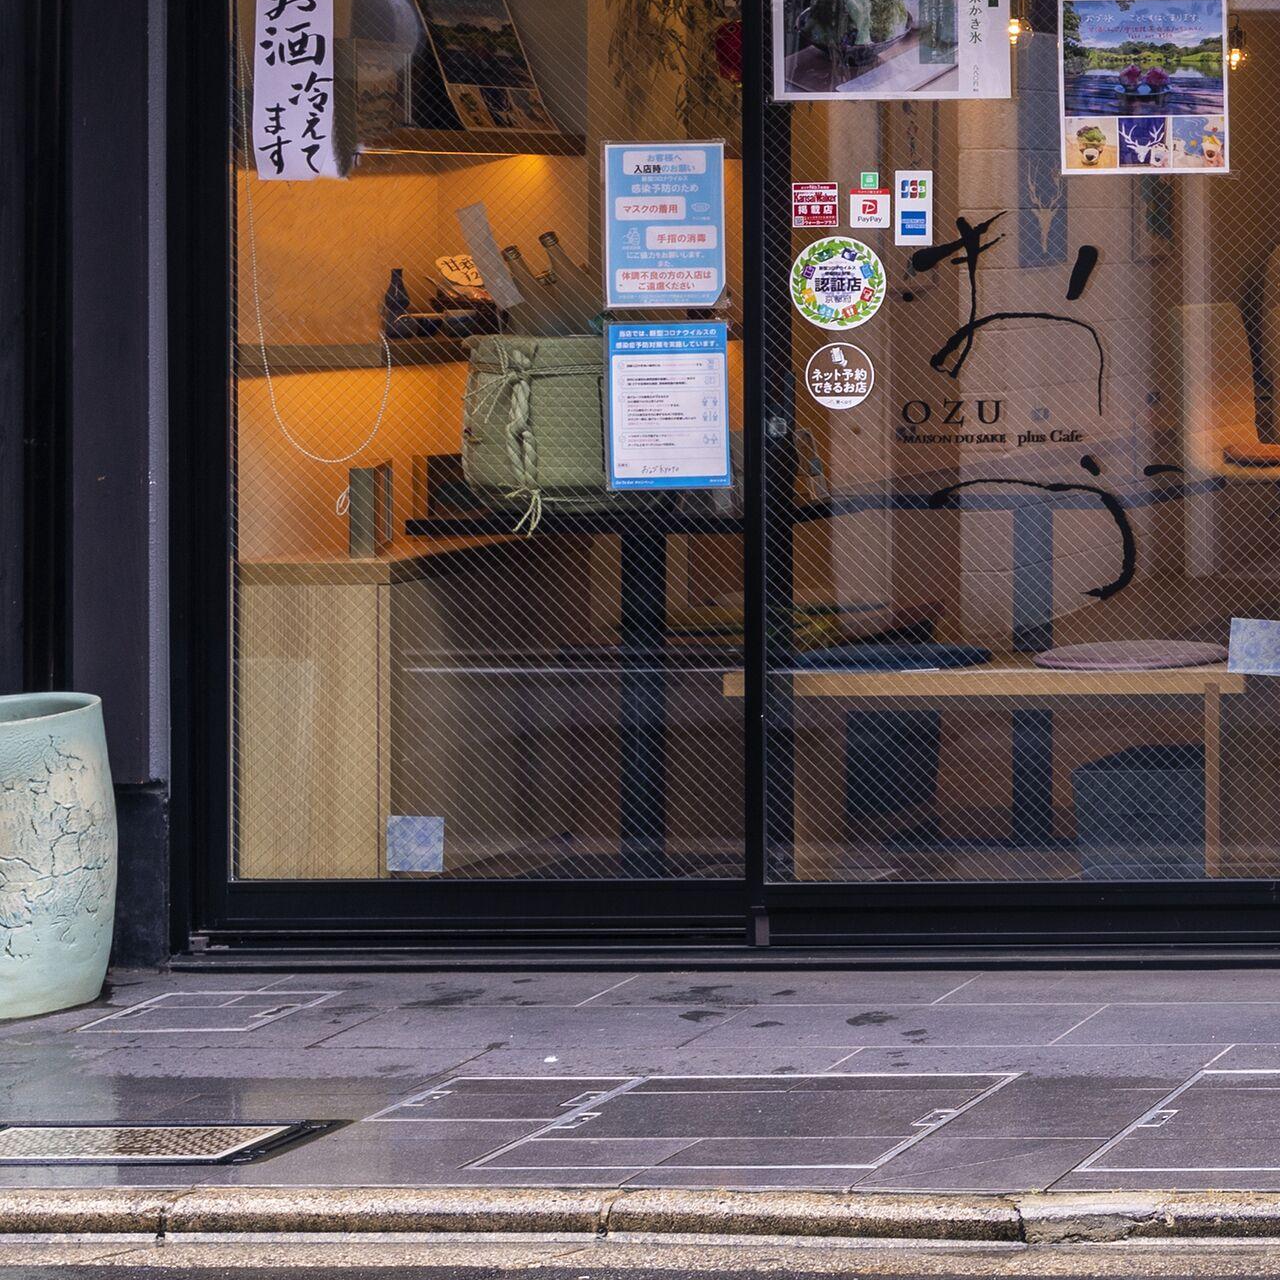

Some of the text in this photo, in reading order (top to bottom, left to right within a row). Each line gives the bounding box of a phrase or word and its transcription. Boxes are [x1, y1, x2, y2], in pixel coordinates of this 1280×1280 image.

[288, 71, 333, 173] 冷えて
[259, 103, 292, 174] ます
[634, 164, 696, 174] 入店時のお願い
[631, 184, 699, 194] 感染予防のため
[623, 204, 678, 214] マスクの着用
[798, 204, 833, 215] 掲載店
[657, 233, 707, 243] 手指の消毒
[622, 271, 712, 280] 体調不良の方の入店は
[638, 282, 695, 290] ご遠慮ください
[814, 277, 861, 292] 認証店
[825, 294, 852, 303] 京都府
[619, 329, 717, 337] 当店では、新型コロナウイルスの
[812, 368, 867, 381] ネット予約
[812, 382, 867, 393] できるお店
[902, 399, 1003, 428] OZU
[903, 429, 1084, 446] MAISON DU SAKE plus Cafe
